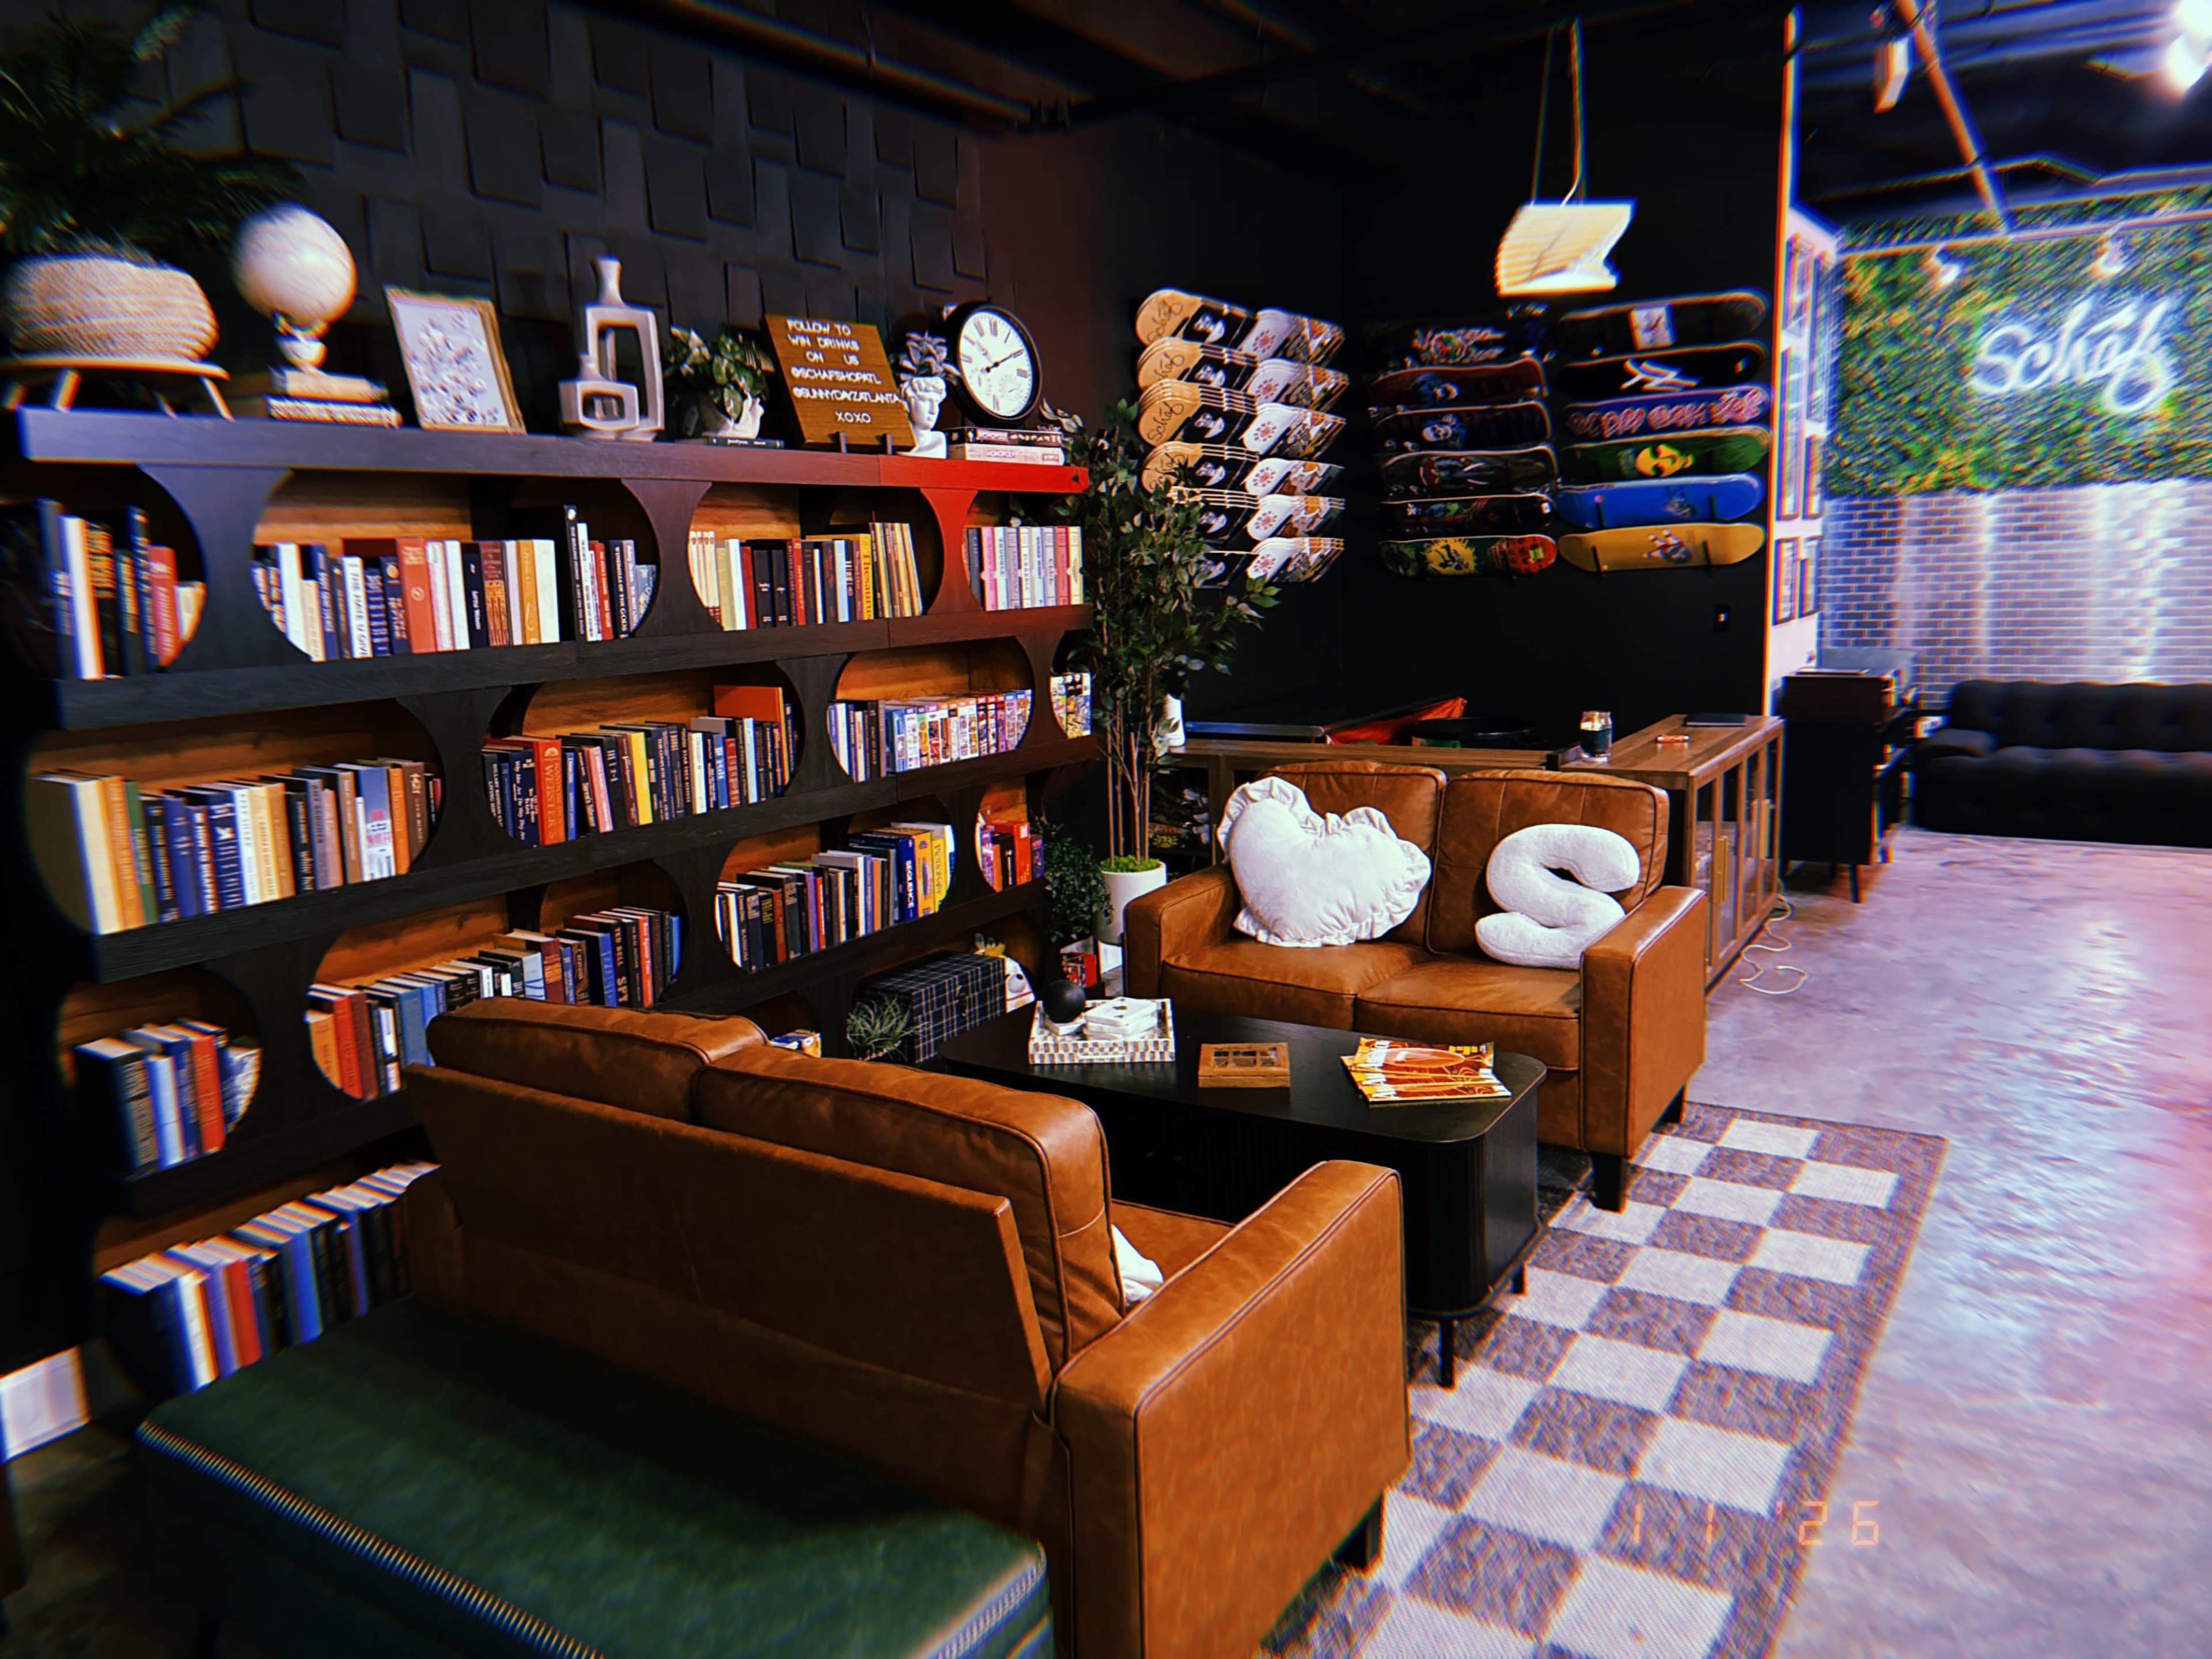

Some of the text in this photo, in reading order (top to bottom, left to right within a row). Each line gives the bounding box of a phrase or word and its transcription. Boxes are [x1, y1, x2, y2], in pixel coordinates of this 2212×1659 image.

[786, 317, 851, 336] FOLLOW TO
[787, 332, 859, 351] WIN DRINKS
[805, 350, 859, 366] ON US
[835, 410, 872, 423] XOXO
[620, 608, 628, 632] GODS
[905, 860, 915, 908] SEQUENCE
[614, 927, 629, 1002] TED BELL SPY
